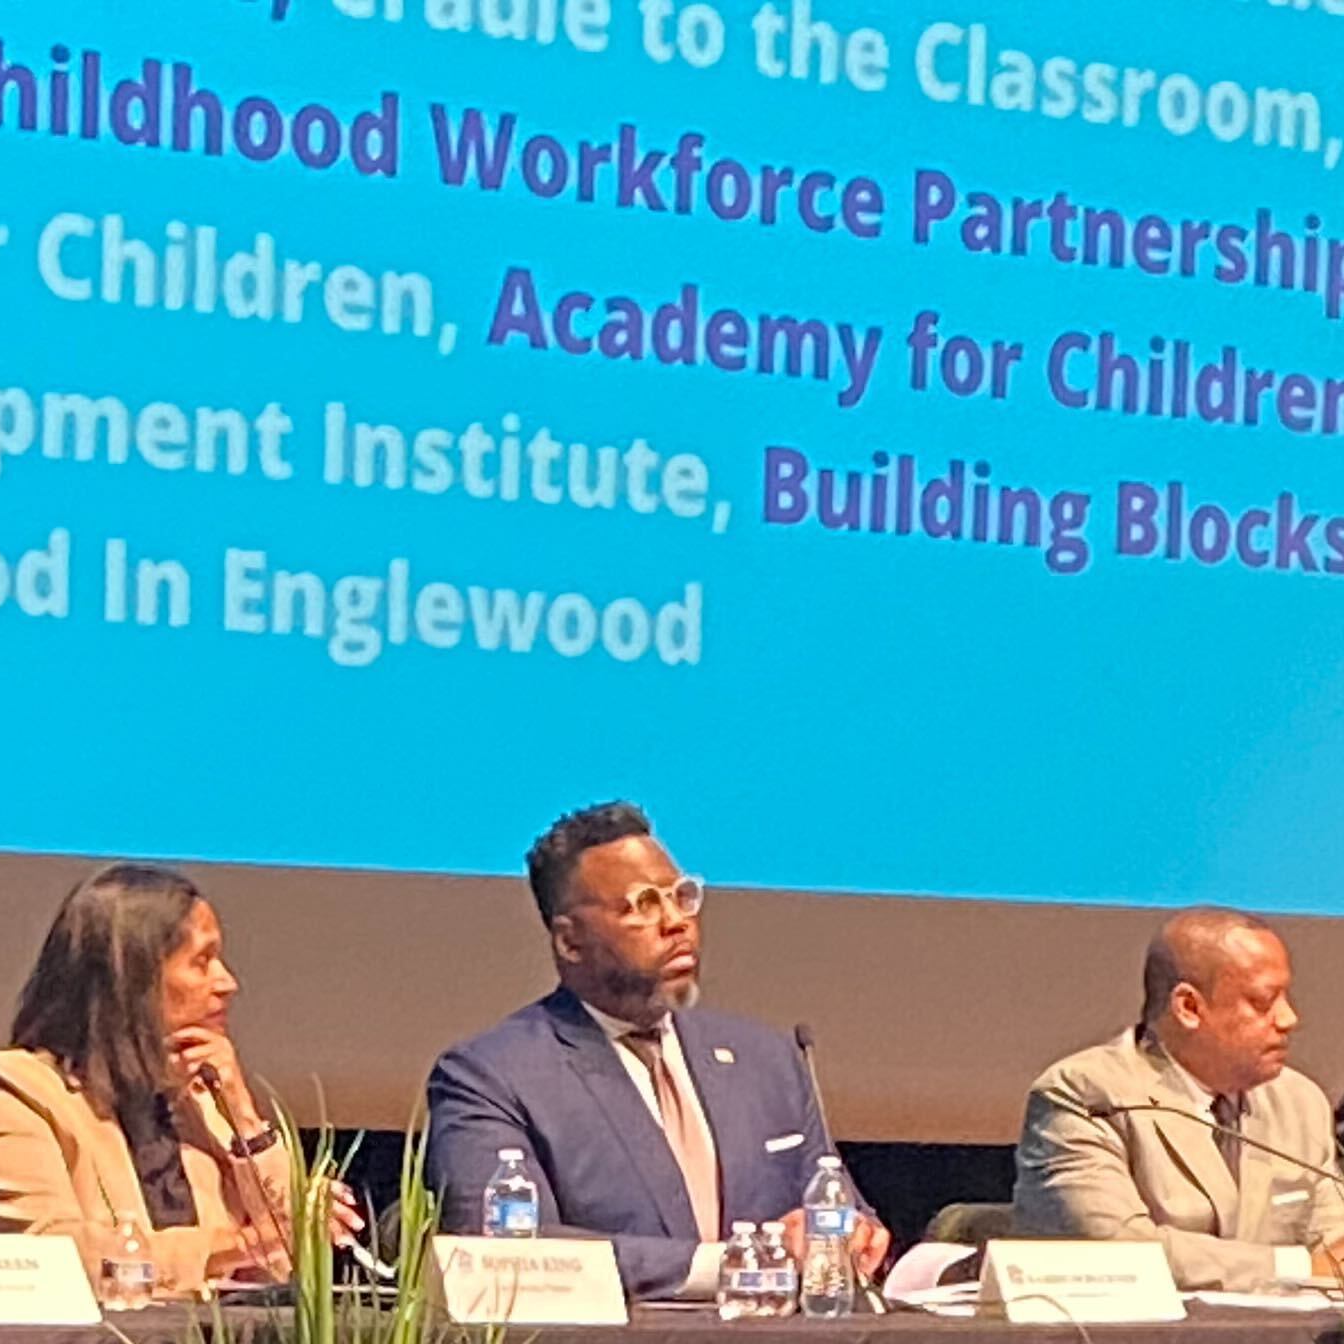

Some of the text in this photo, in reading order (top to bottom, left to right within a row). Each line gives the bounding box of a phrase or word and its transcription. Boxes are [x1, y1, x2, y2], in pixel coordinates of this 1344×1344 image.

[637, 0, 726, 68] to
[751, 0, 889, 92] the
[915, 22, 1343, 168] Classroom,
[428, 101, 886, 240] Workforce
[36, 212, 458, 355] Children,
[485, 265, 884, 410] Academy
[905, 308, 1024, 400] for
[323, 402, 731, 534] Institute,
[761, 444, 1092, 575] Building
[103, 538, 191, 628] In
[223, 547, 703, 668] Englewood
